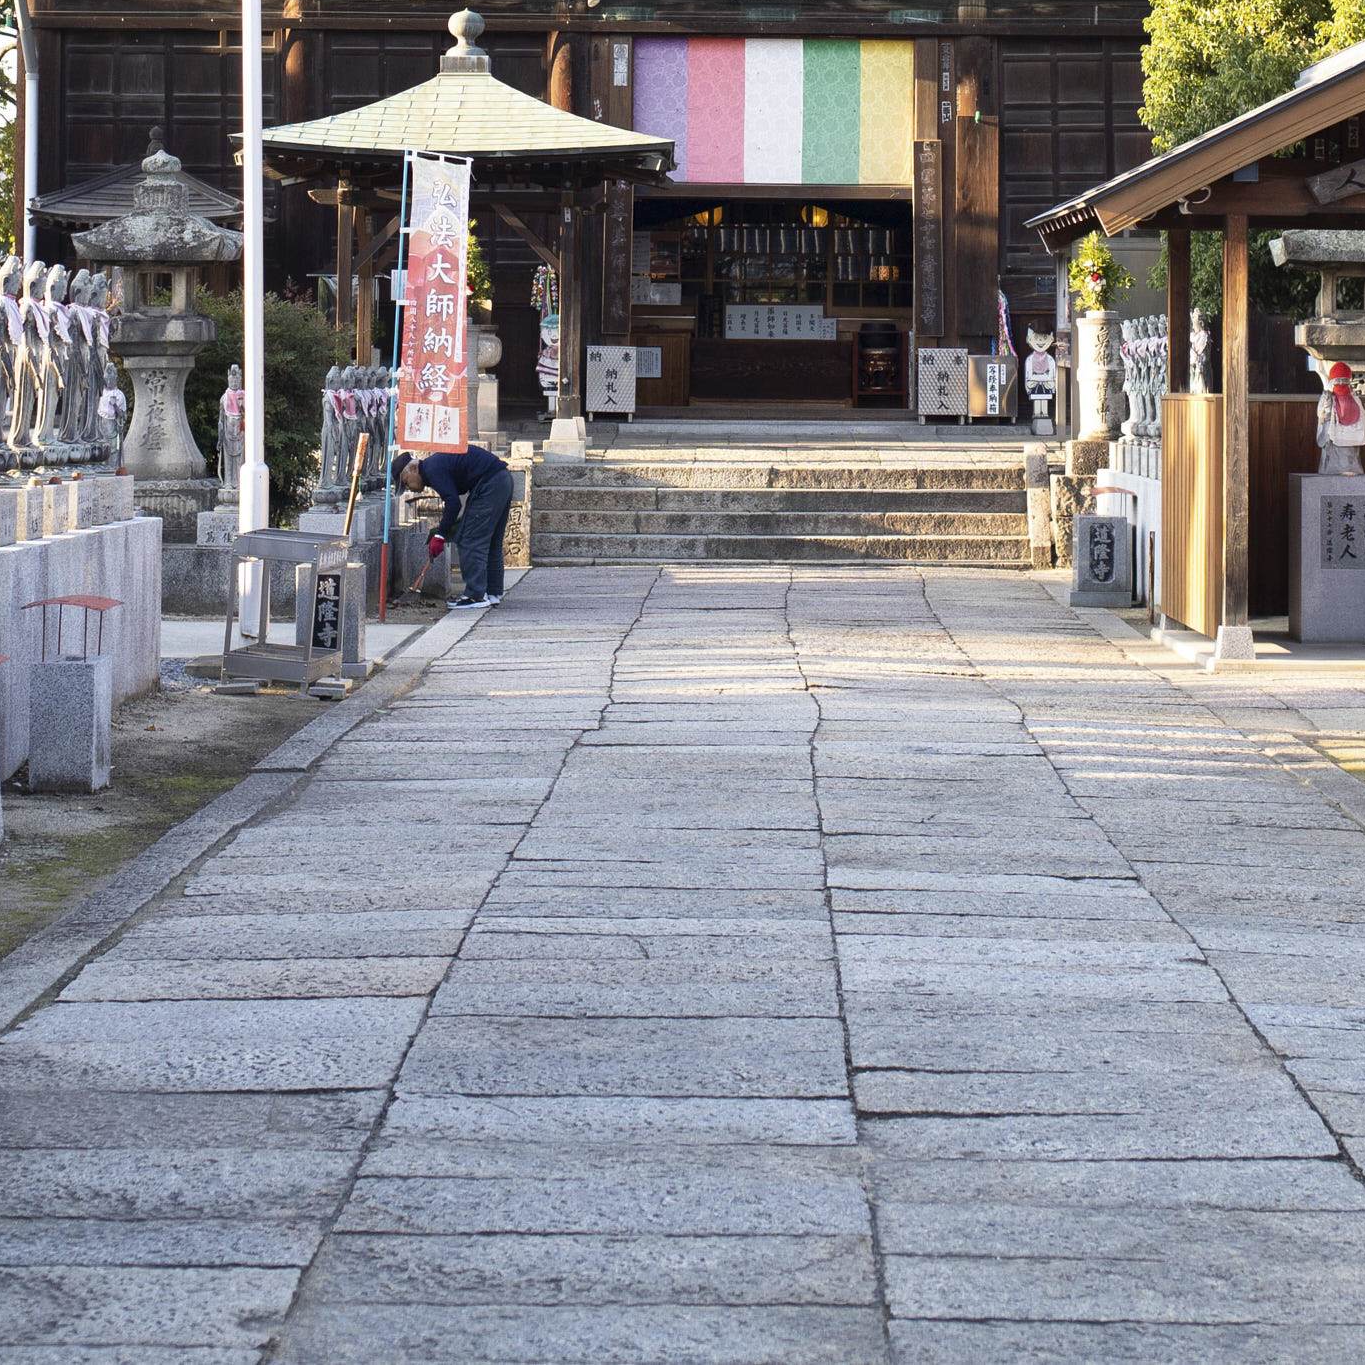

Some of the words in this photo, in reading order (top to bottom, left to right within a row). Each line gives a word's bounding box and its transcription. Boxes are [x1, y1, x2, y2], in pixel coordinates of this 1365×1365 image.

[419, 178, 458, 394] 弘法大師納経
[604, 368, 618, 405] 納札入
[937, 371, 949, 410] 納札入
[1094, 525, 1112, 580] 道隆寺
[1338, 502, 1358, 562] 寿老人
[317, 577, 339, 648] 道隆寺
